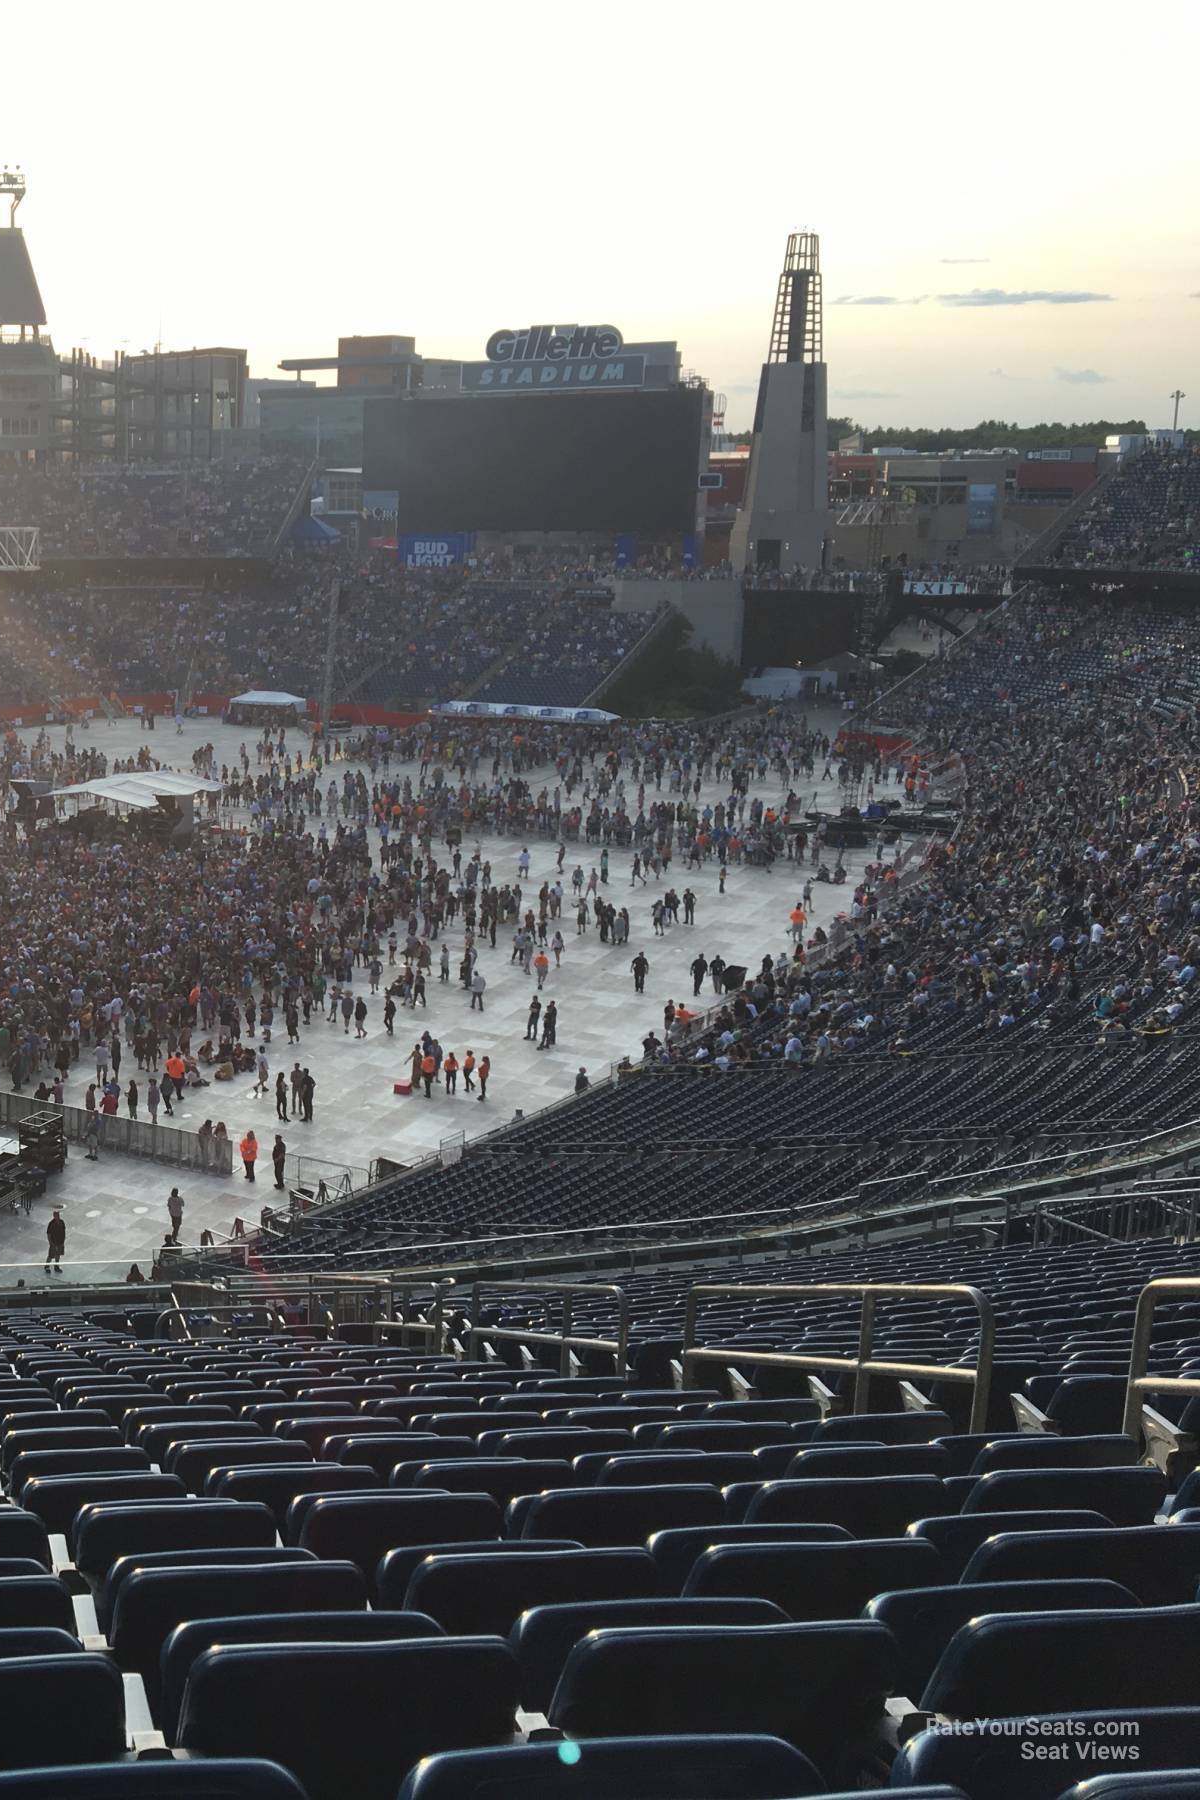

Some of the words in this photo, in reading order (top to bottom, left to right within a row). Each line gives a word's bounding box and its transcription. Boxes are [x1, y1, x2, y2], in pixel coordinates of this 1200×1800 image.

[486, 326, 622, 362] Gillette
[479, 364, 625, 385] STADIUM
[414, 541, 449, 555] BUD
[407, 554, 455, 568] LIGHT
[910, 583, 960, 595] EXIT
